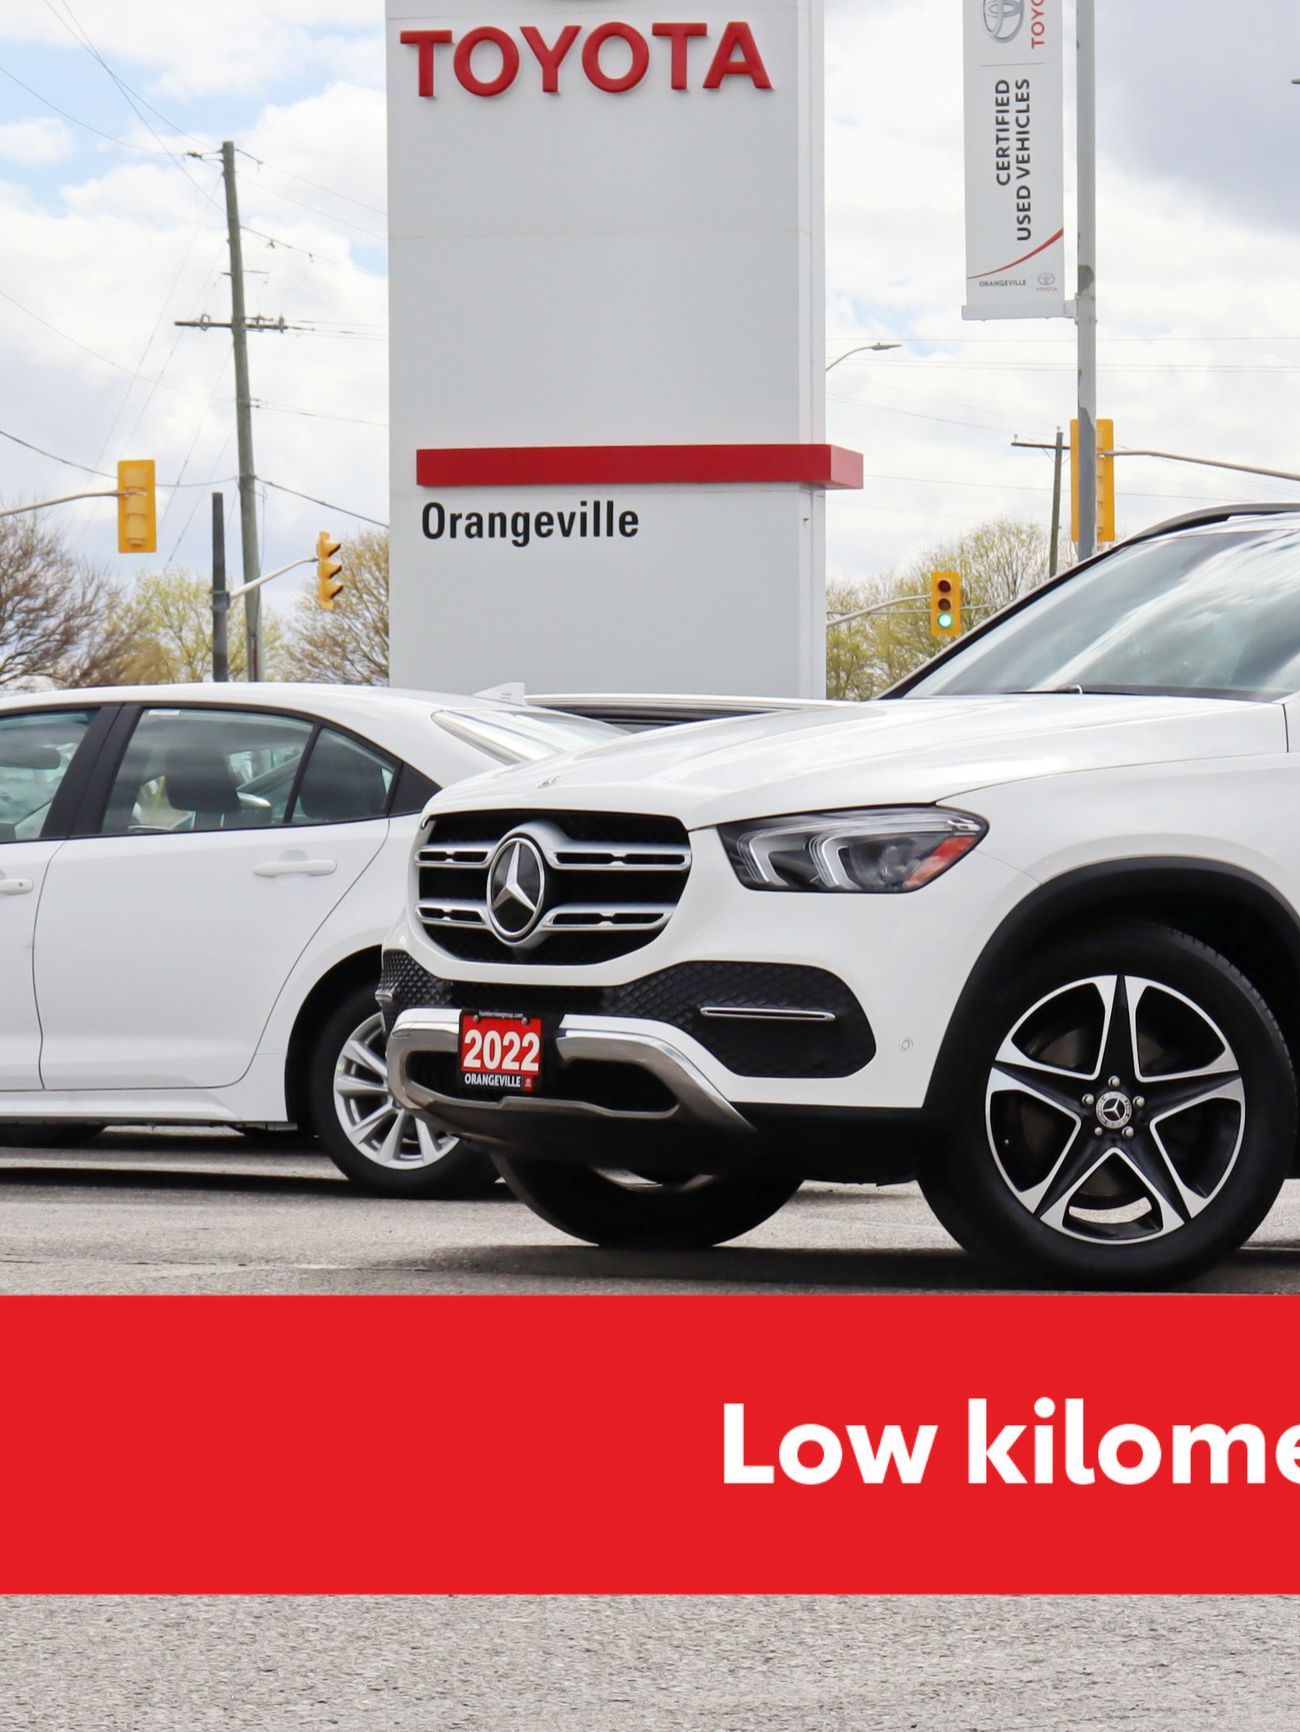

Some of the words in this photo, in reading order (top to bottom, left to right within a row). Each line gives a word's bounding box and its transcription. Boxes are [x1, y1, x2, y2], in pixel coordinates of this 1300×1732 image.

[1031, 0, 1045, 49] TOY
[400, 21, 774, 98] TOYOTA
[995, 79, 1011, 186] CERTIFIED
[1015, 78, 1031, 180] VEHICLES
[1016, 184, 1032, 241] USED
[421, 500, 640, 547] Orangeville
[463, 1028, 540, 1072] 2022
[464, 1073, 521, 1088] ORANGEVILLE
